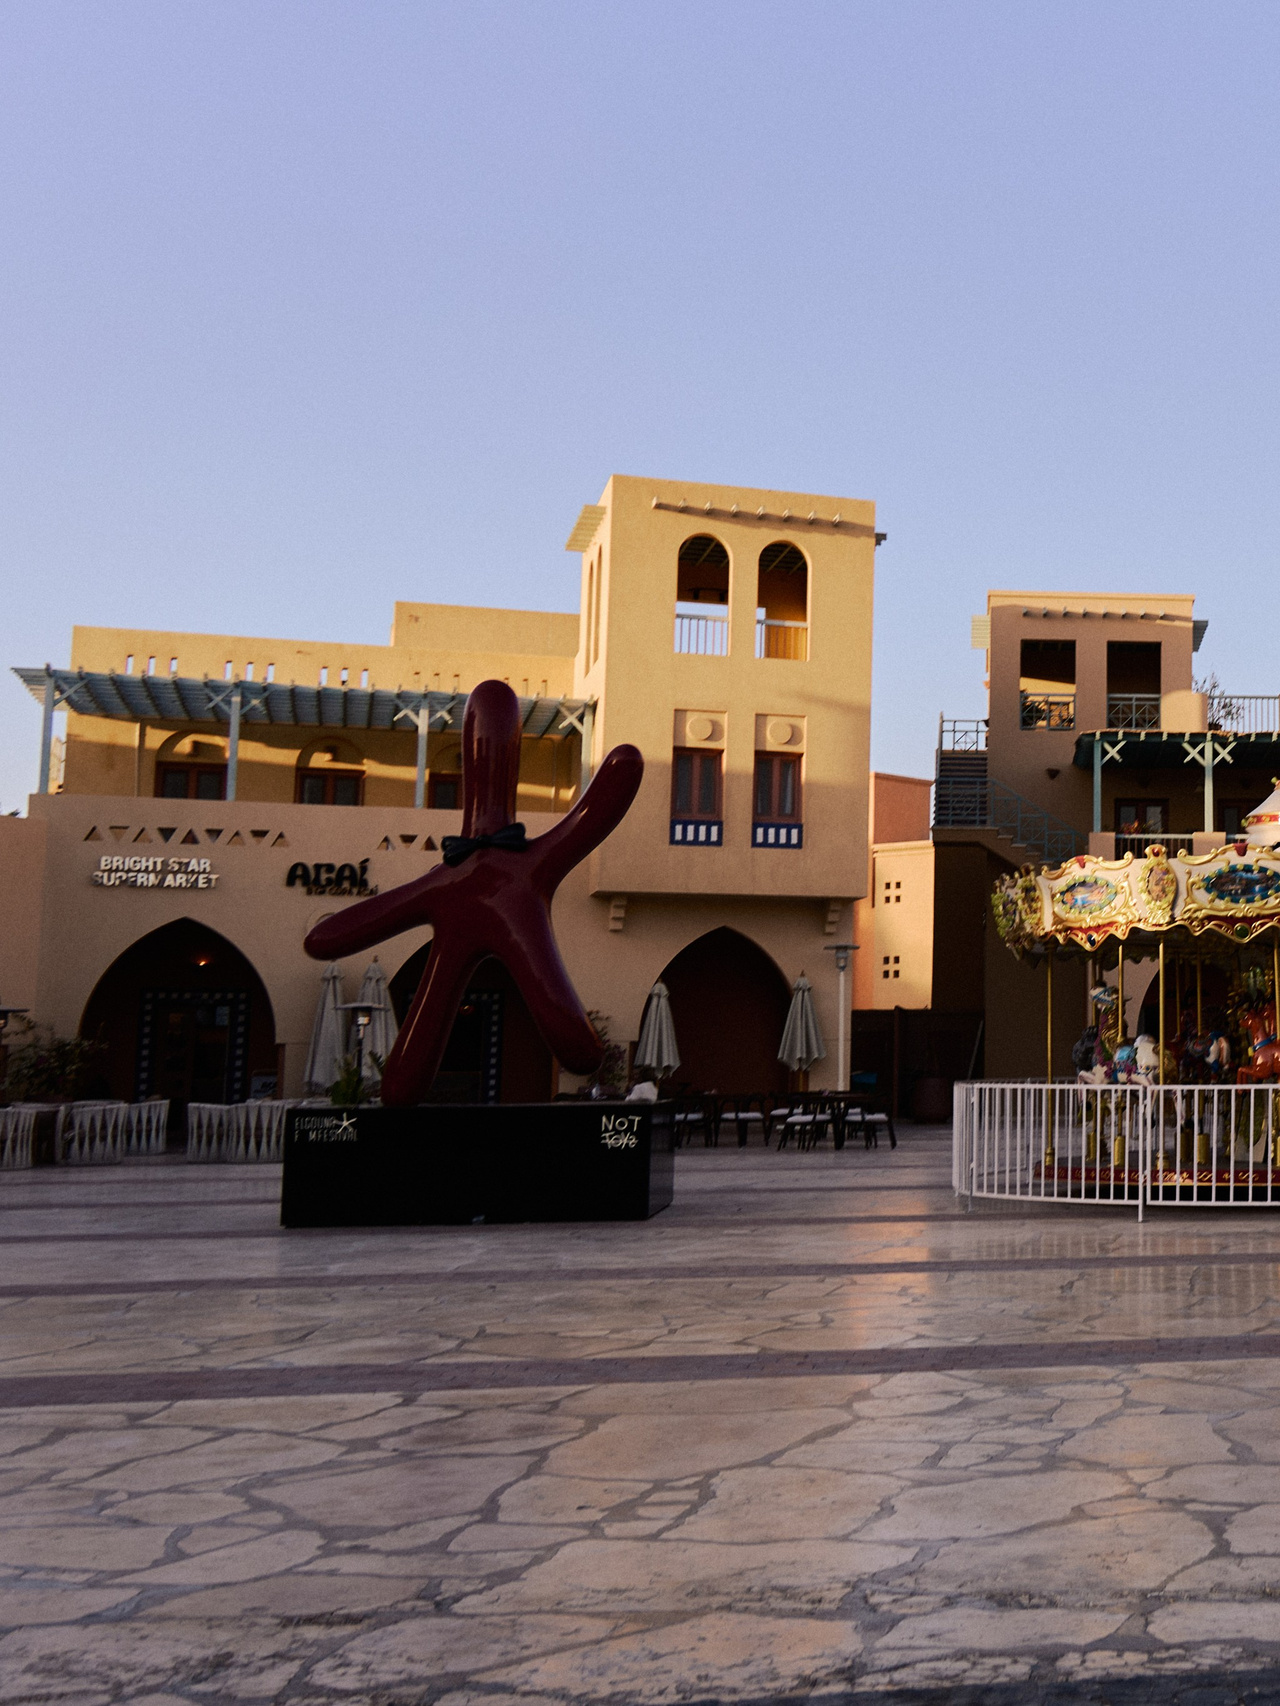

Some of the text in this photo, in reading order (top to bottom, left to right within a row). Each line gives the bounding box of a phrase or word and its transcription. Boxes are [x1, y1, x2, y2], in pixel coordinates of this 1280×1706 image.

[99, 855, 212, 873] BRIGHT STAR
[91, 870, 220, 889] SUPERMARKET
[601, 1114, 643, 1132] NOT
